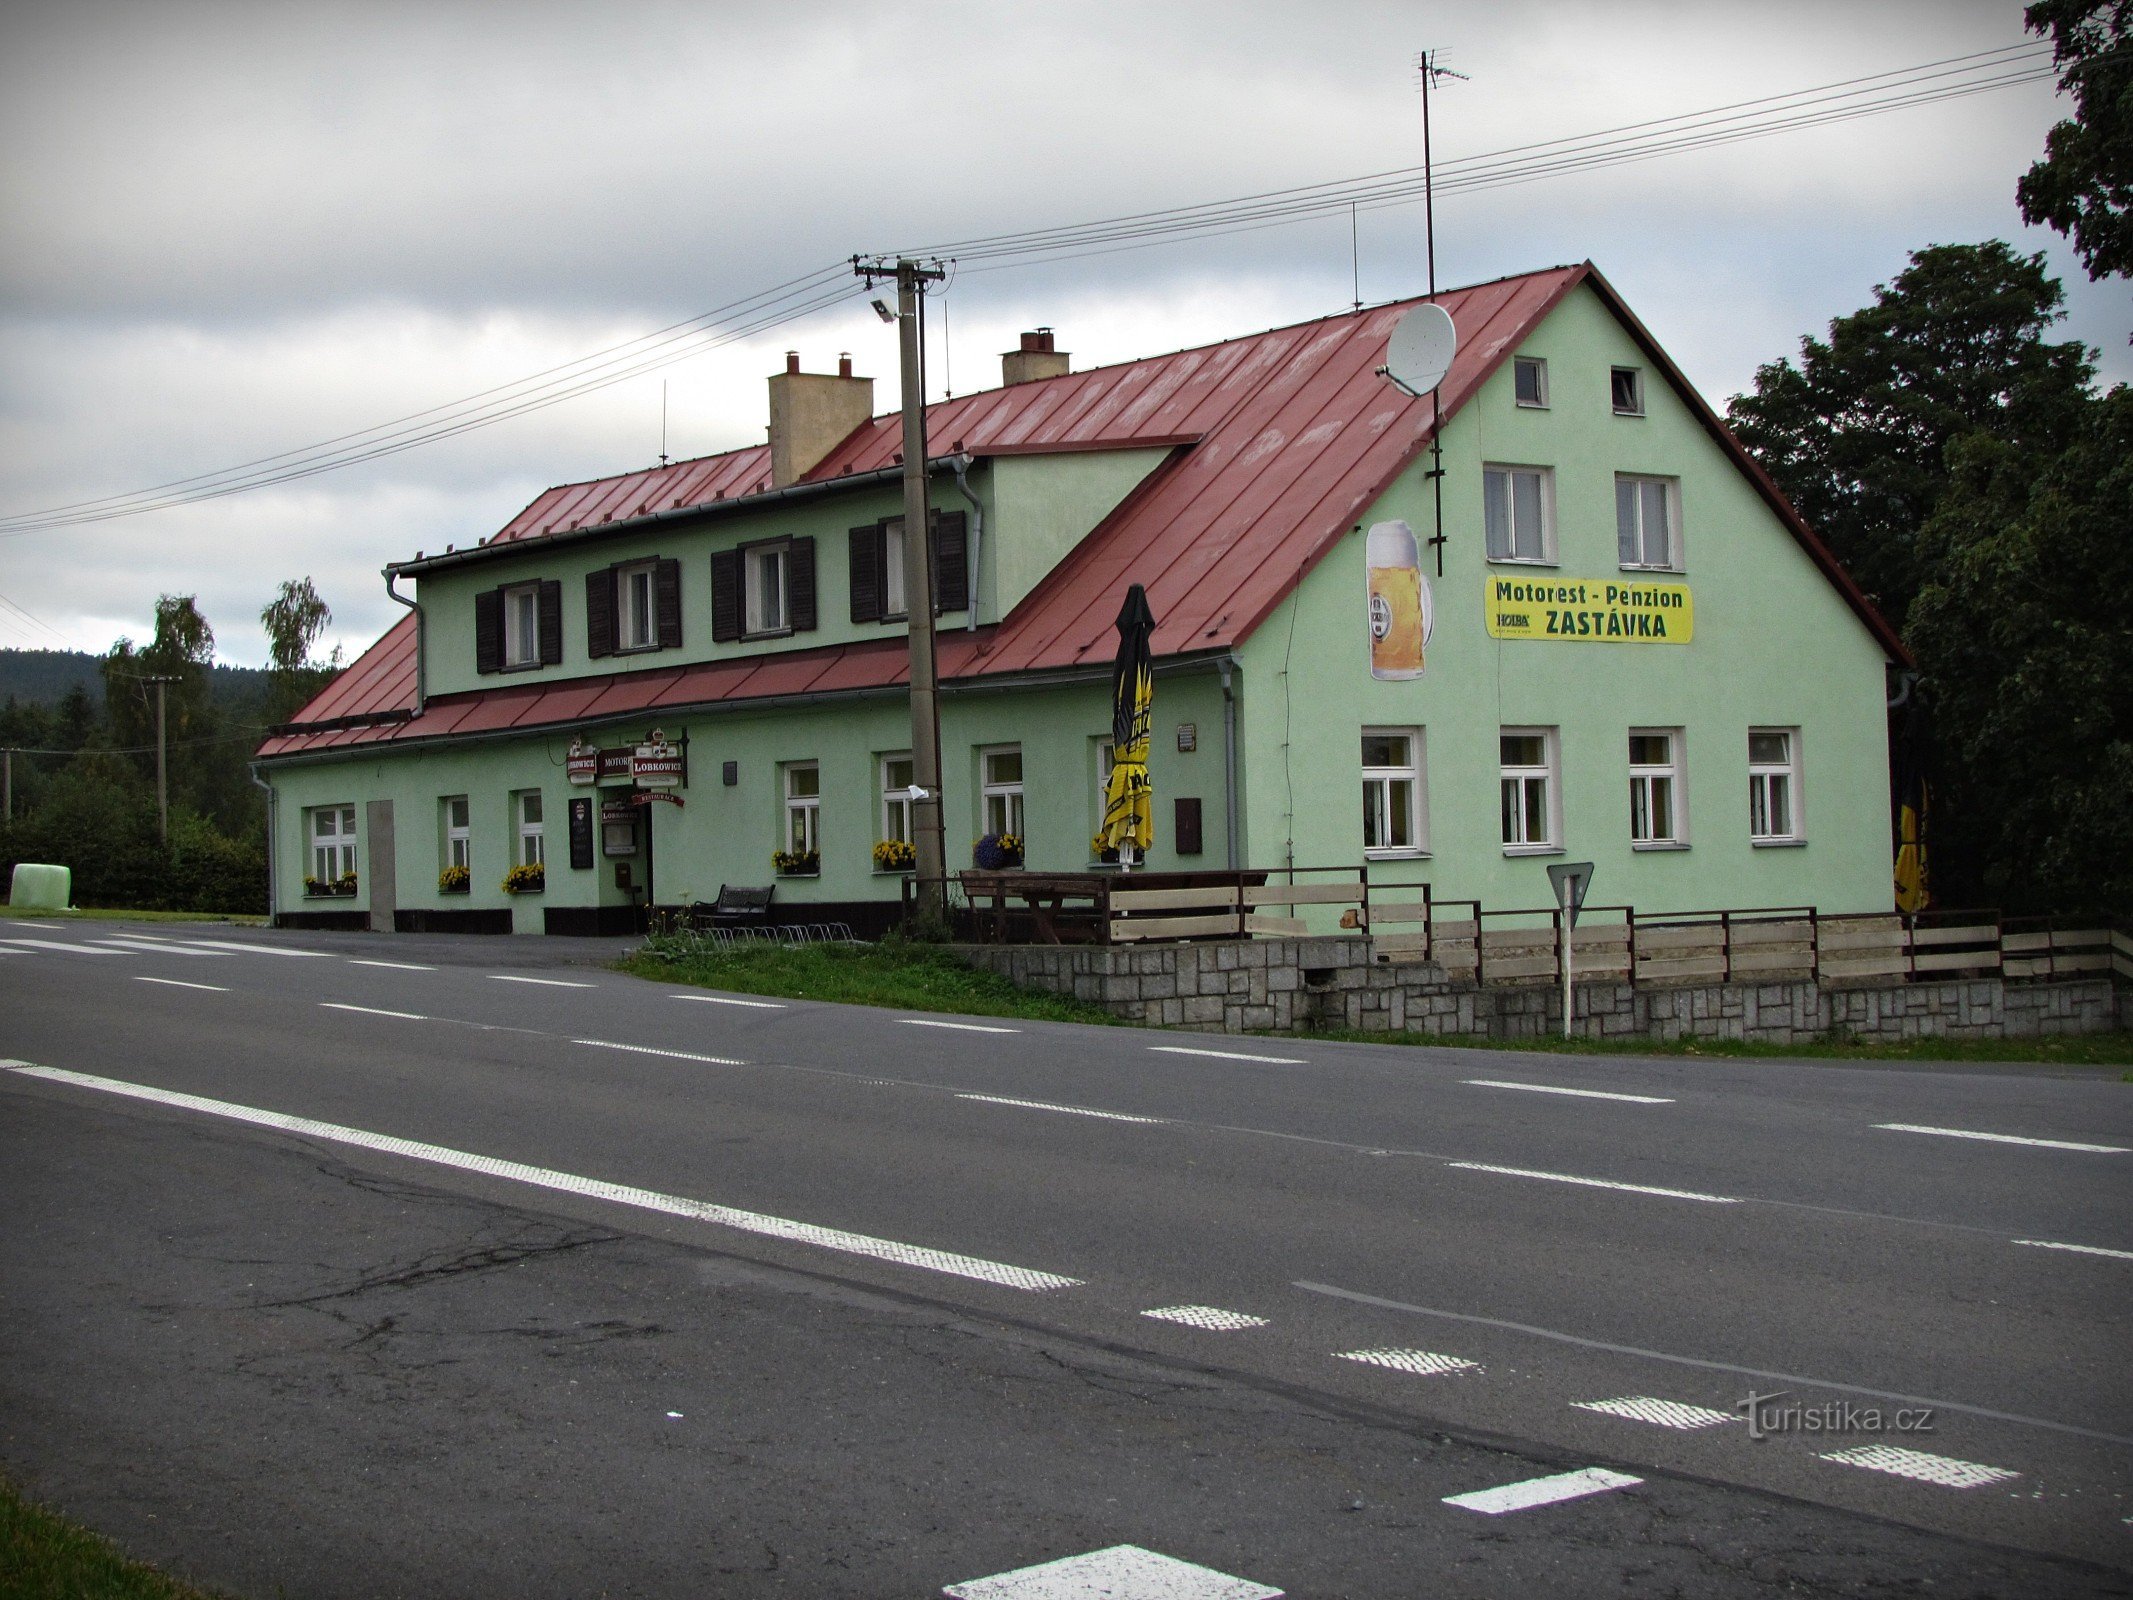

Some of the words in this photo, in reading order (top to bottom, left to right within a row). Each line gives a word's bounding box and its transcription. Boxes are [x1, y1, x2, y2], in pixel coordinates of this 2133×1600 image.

[1496, 582, 1586, 604] Motorest
[1606, 585, 1683, 608] Penzion
[1546, 608, 1667, 637] ZASTÁVKA
[634, 763, 682, 772] LOBKOWICZ
